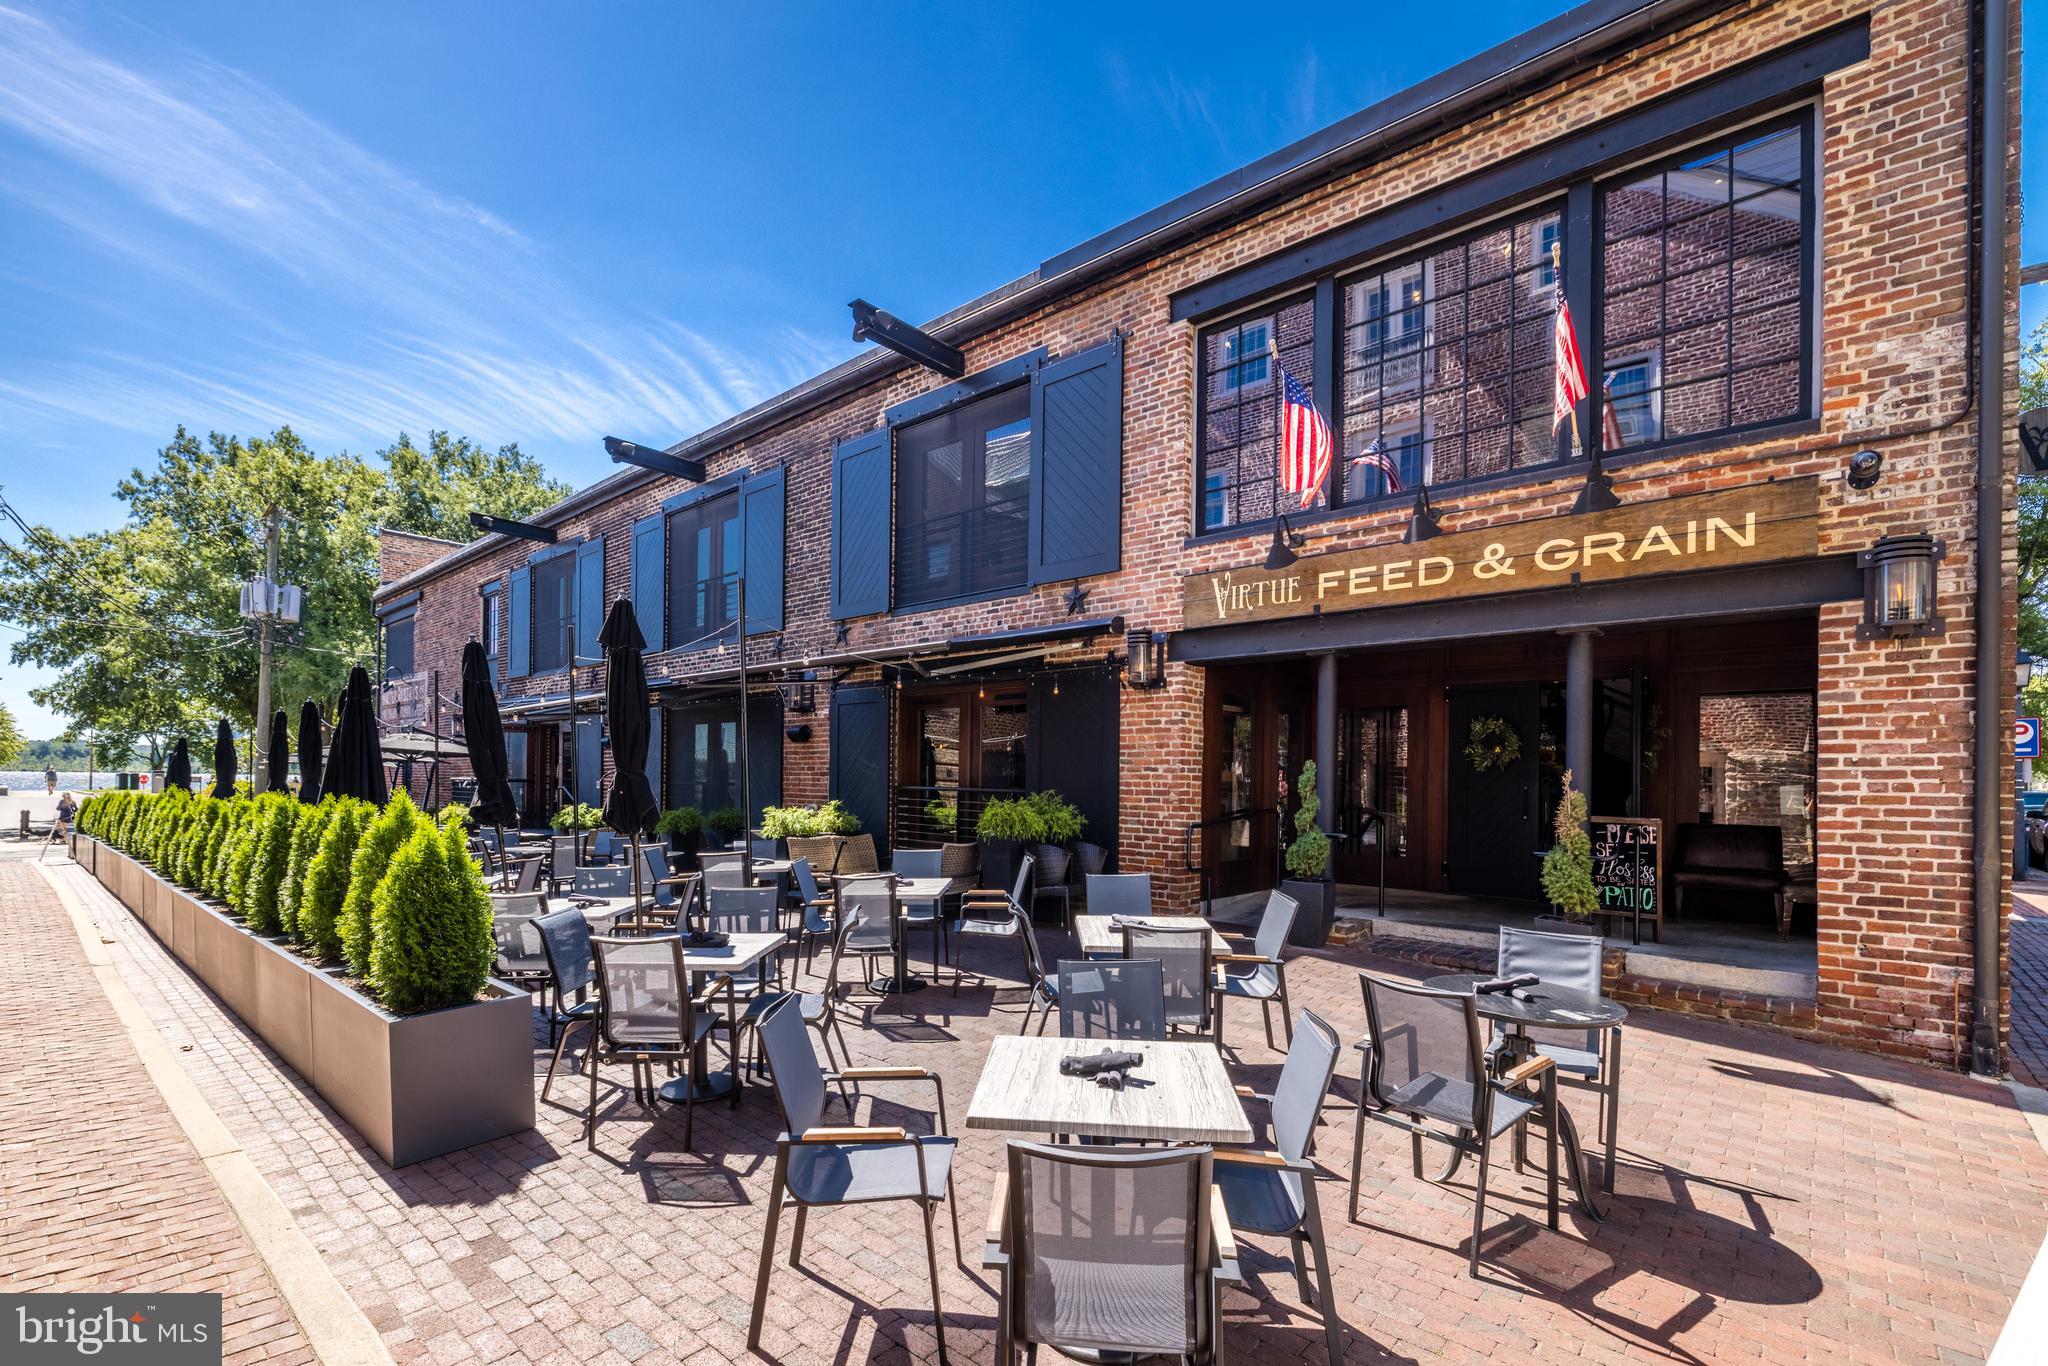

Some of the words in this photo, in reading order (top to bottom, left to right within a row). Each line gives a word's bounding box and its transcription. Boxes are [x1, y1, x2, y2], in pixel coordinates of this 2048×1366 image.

[1318, 556, 1455, 599] FEED
[1472, 543, 1516, 579] &
[1534, 511, 1756, 571] GRAIN
